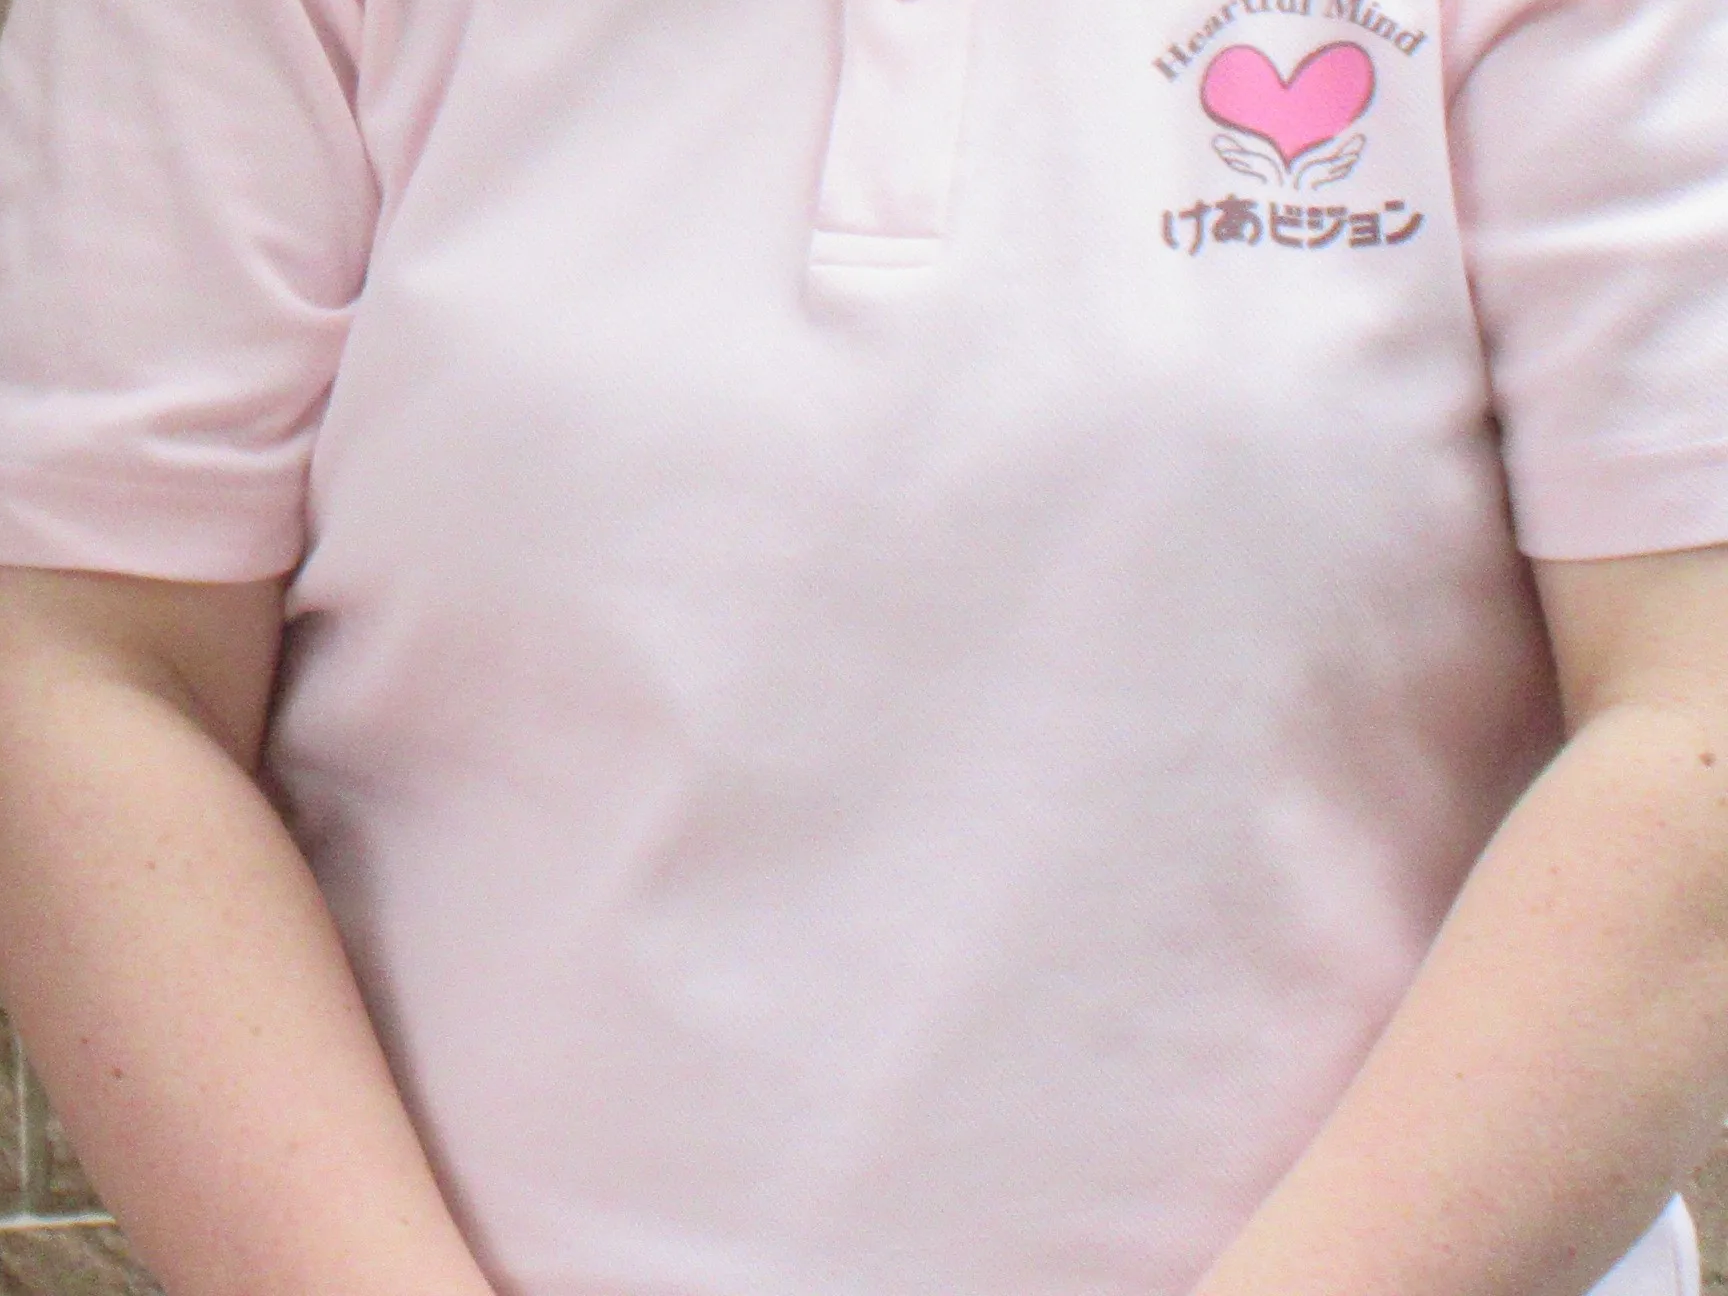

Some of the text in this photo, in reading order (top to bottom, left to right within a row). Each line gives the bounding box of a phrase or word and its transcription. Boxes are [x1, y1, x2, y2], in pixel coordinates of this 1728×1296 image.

[1161, 193, 1425, 256] けあビジョン
